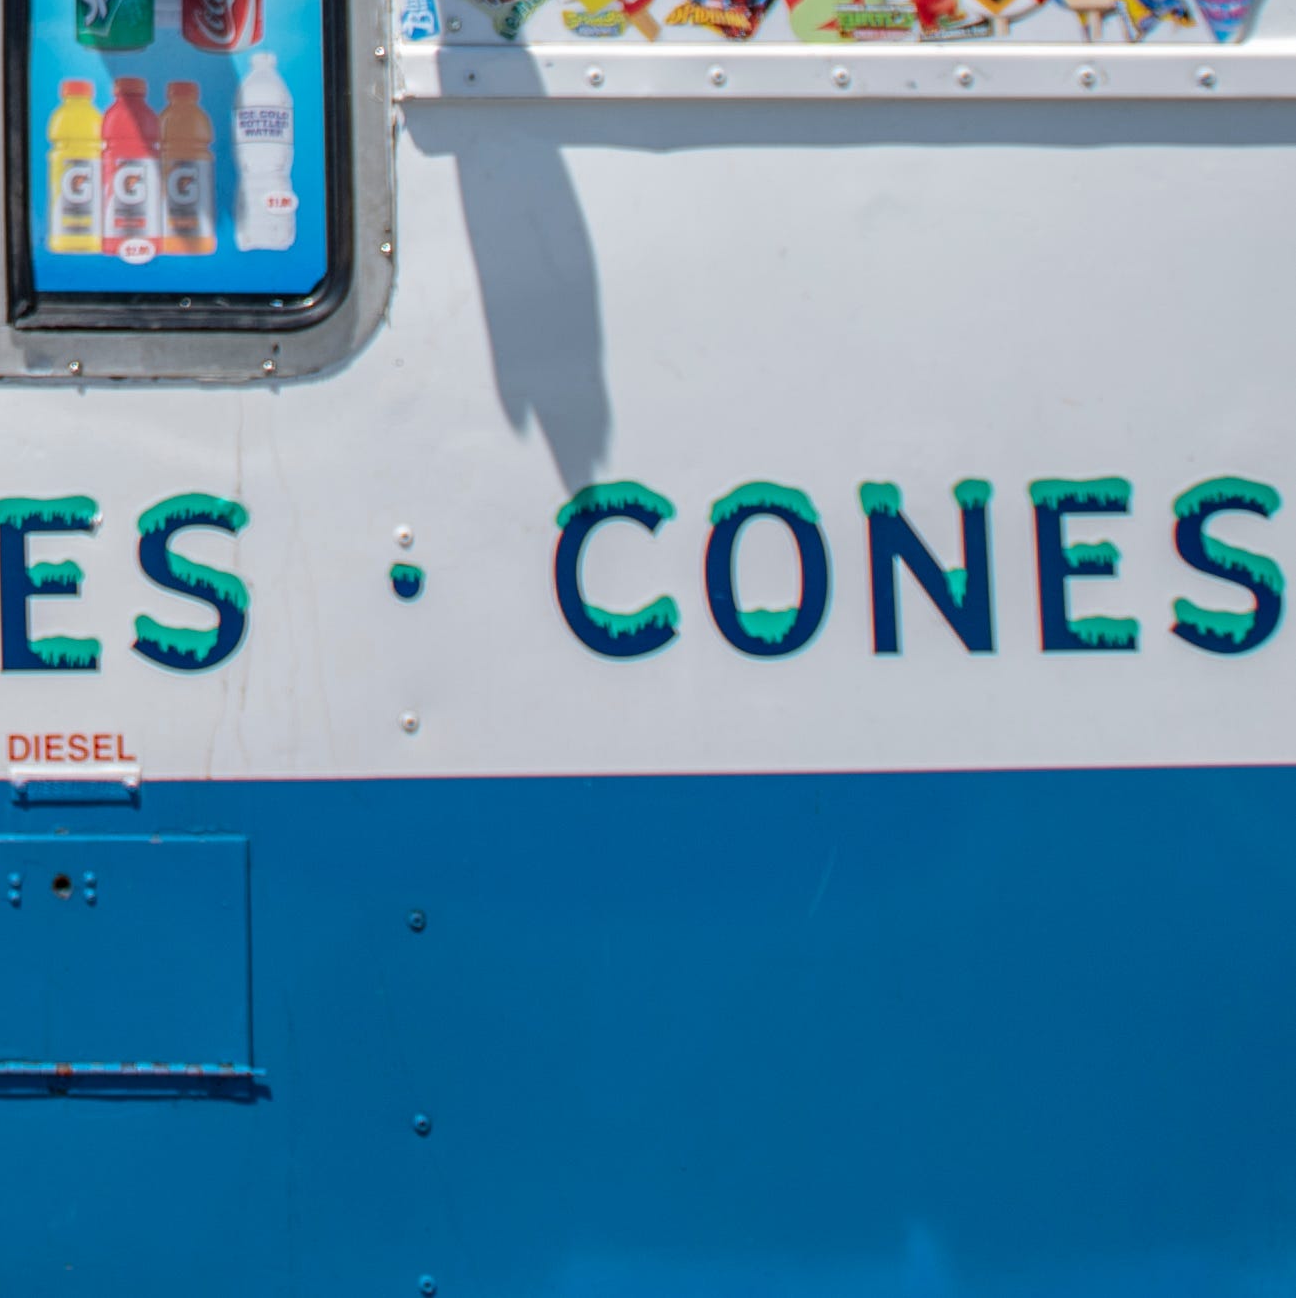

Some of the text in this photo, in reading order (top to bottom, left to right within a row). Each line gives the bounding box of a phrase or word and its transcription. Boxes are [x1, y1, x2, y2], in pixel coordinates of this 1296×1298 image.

[62, 166, 93, 204] G
[113, 166, 145, 204] G
[553, 475, 1287, 660] CONES
[7, 733, 138, 763] DIESEL
